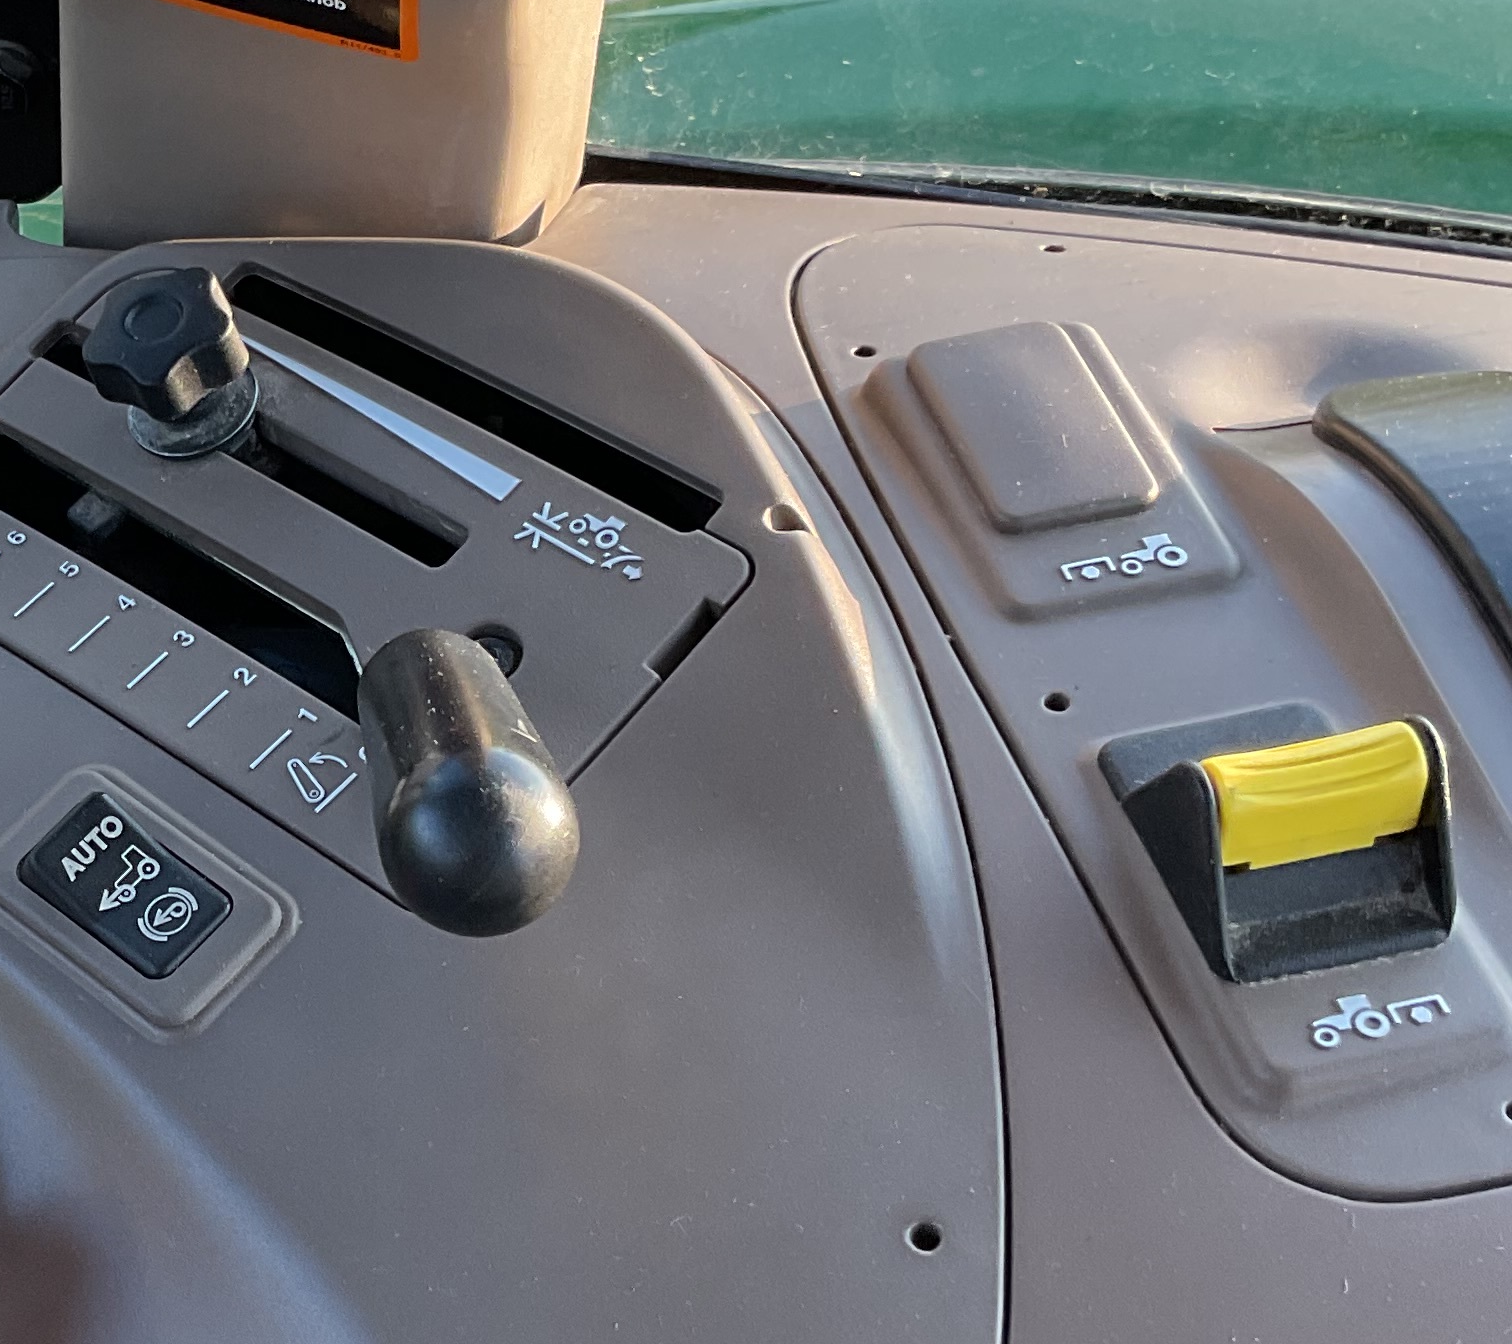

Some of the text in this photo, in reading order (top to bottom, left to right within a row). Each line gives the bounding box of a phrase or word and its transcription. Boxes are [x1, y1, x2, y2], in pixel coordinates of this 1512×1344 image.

[6, 530, 27, 545] 6
[58, 560, 80, 578] 5
[117, 594, 137, 611] 4
[173, 630, 195, 648] 3
[233, 667, 257, 686] 2
[297, 707, 318, 723] 1
[61, 815, 124, 882] AUTO
